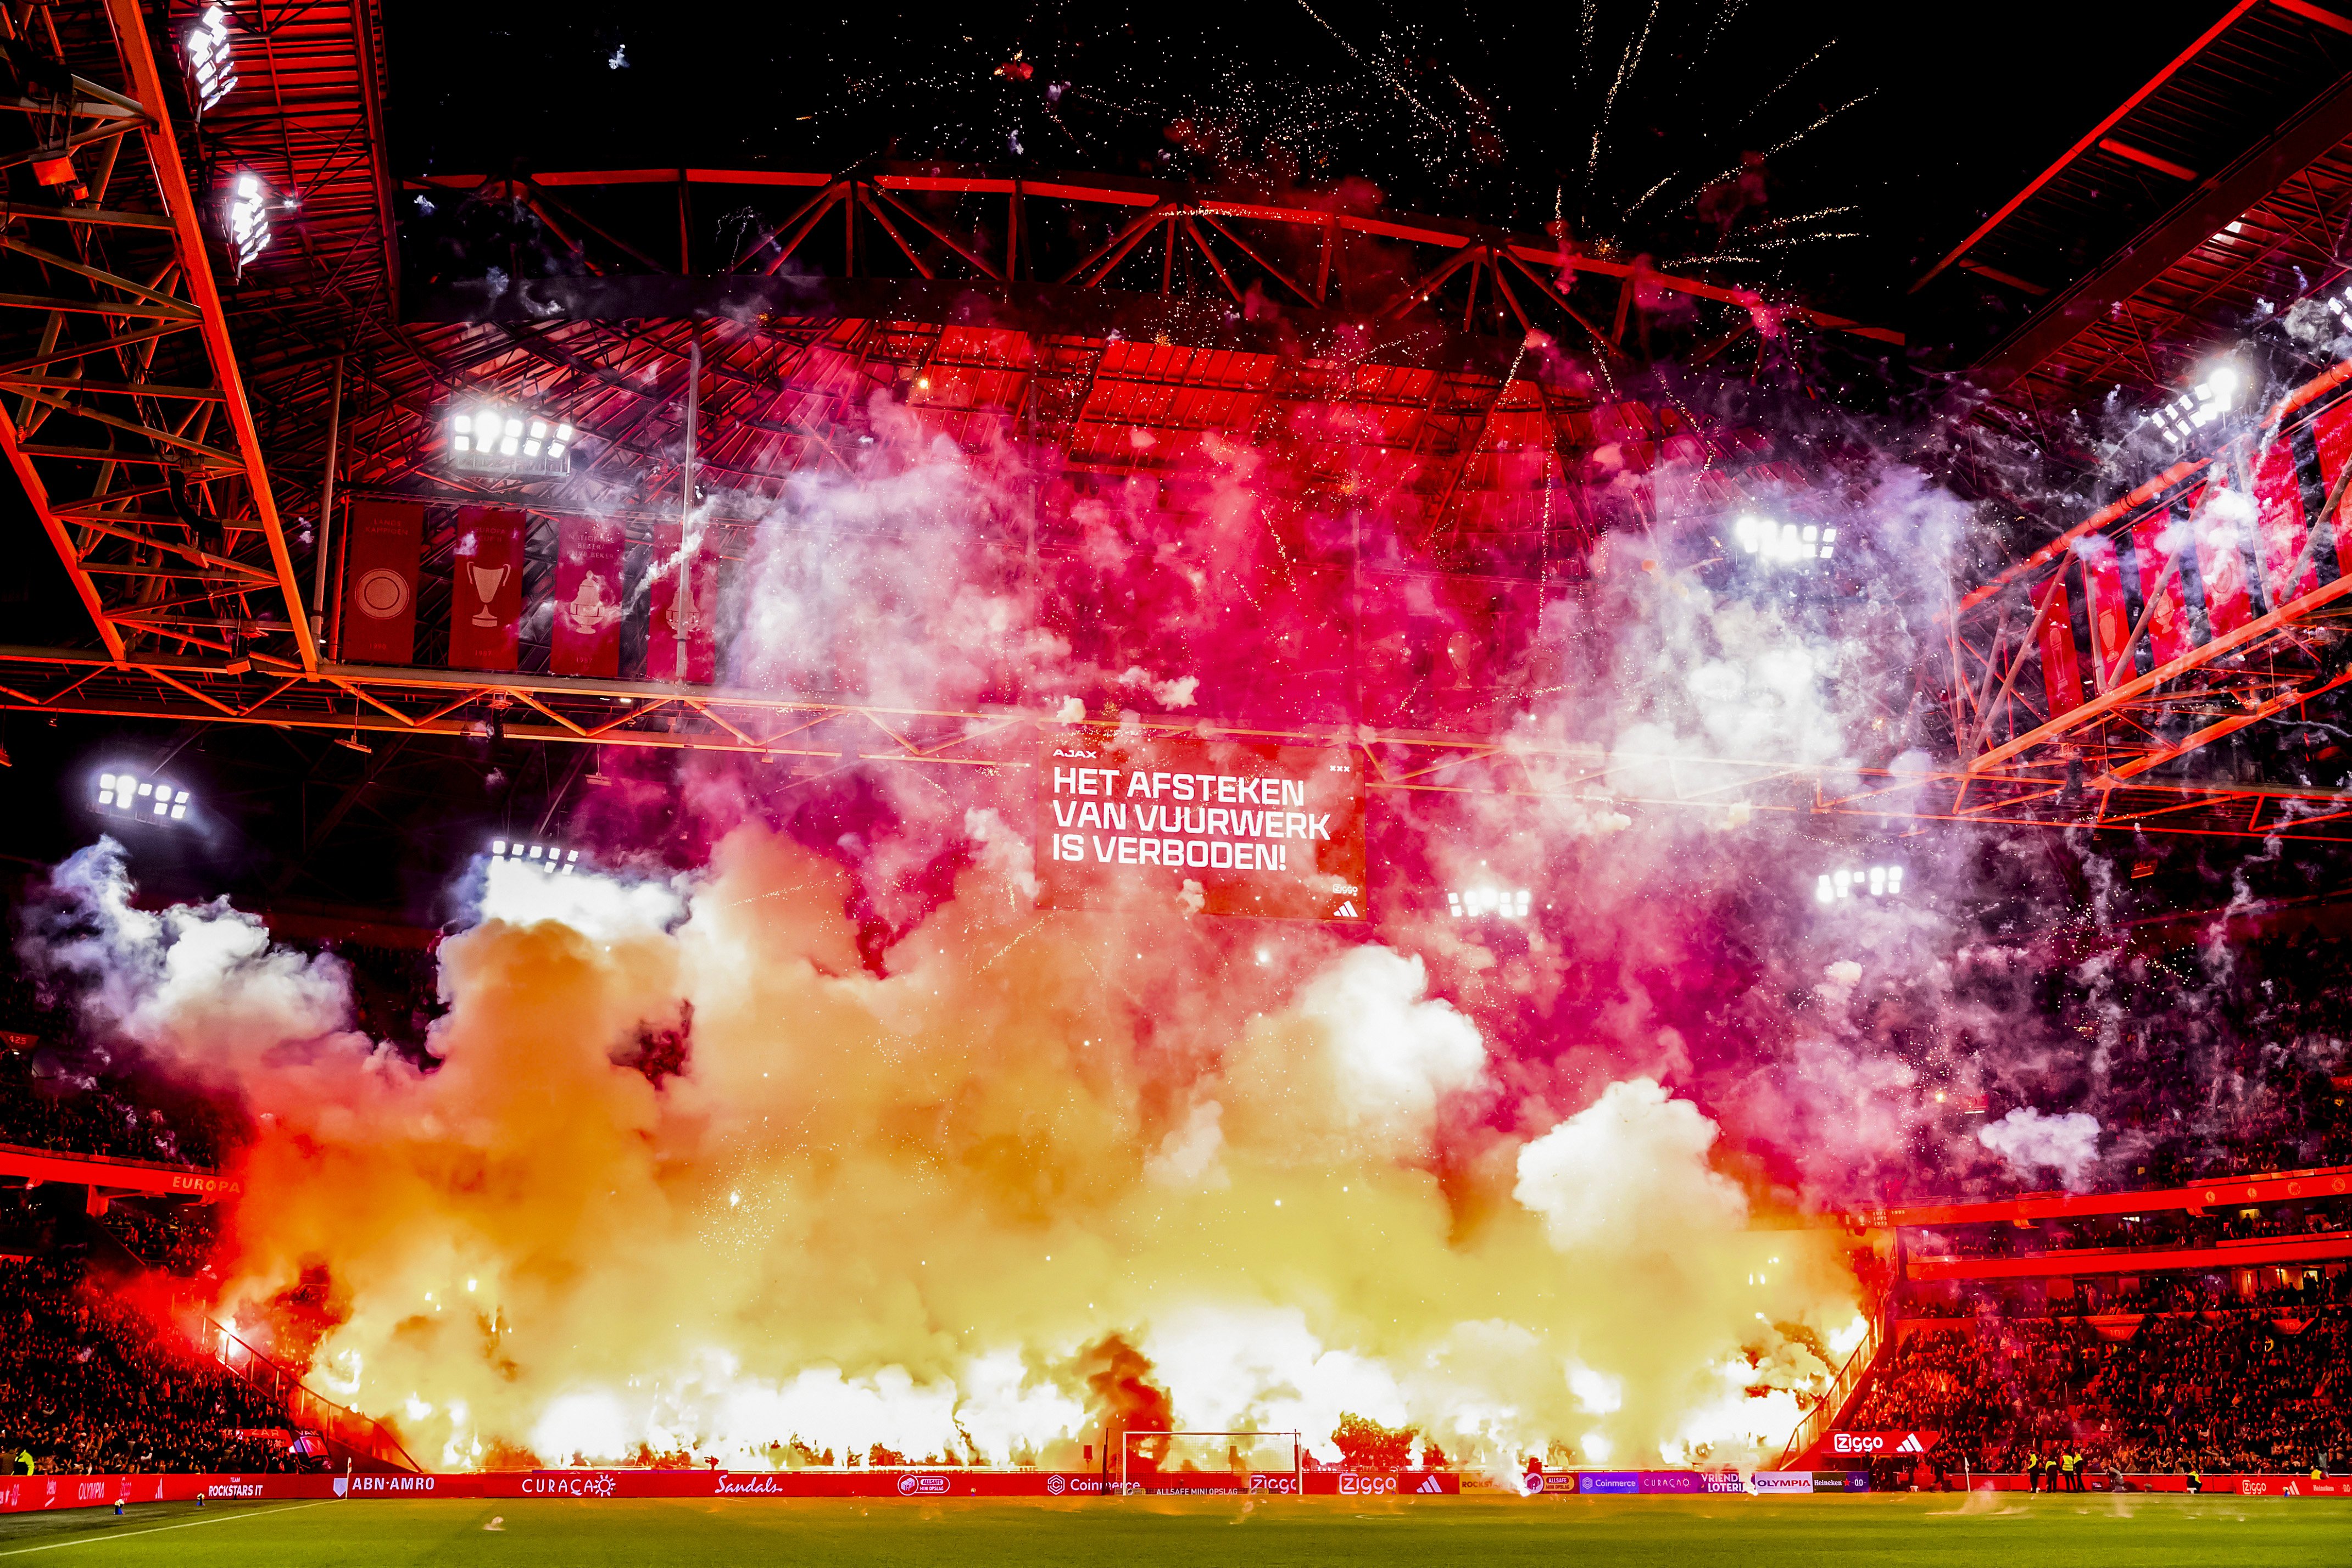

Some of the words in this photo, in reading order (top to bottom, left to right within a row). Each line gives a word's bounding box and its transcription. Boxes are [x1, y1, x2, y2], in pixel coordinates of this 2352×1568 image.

[1053, 749, 1097, 759] AJAX
[1053, 766, 1119, 797] HET
[1126, 771, 1304, 806] AFSTEKEN
[1052, 799, 1126, 830] VAN
[1136, 805, 1331, 840] VUURWERK
[1052, 833, 1084, 861] IS
[1093, 835, 1287, 871] VERBODEN!
[9, 1036, 27, 1044] 425
[172, 1176, 241, 1193] EUROPA
[78, 1482, 104, 1500] OLYMPIA
[208, 1485, 254, 1497] ROCKSTARS
[255, 1485, 263, 1496] IT
[715, 1475, 783, 1493] Sandals
[1595, 1479, 1636, 1487] Coinmerce
